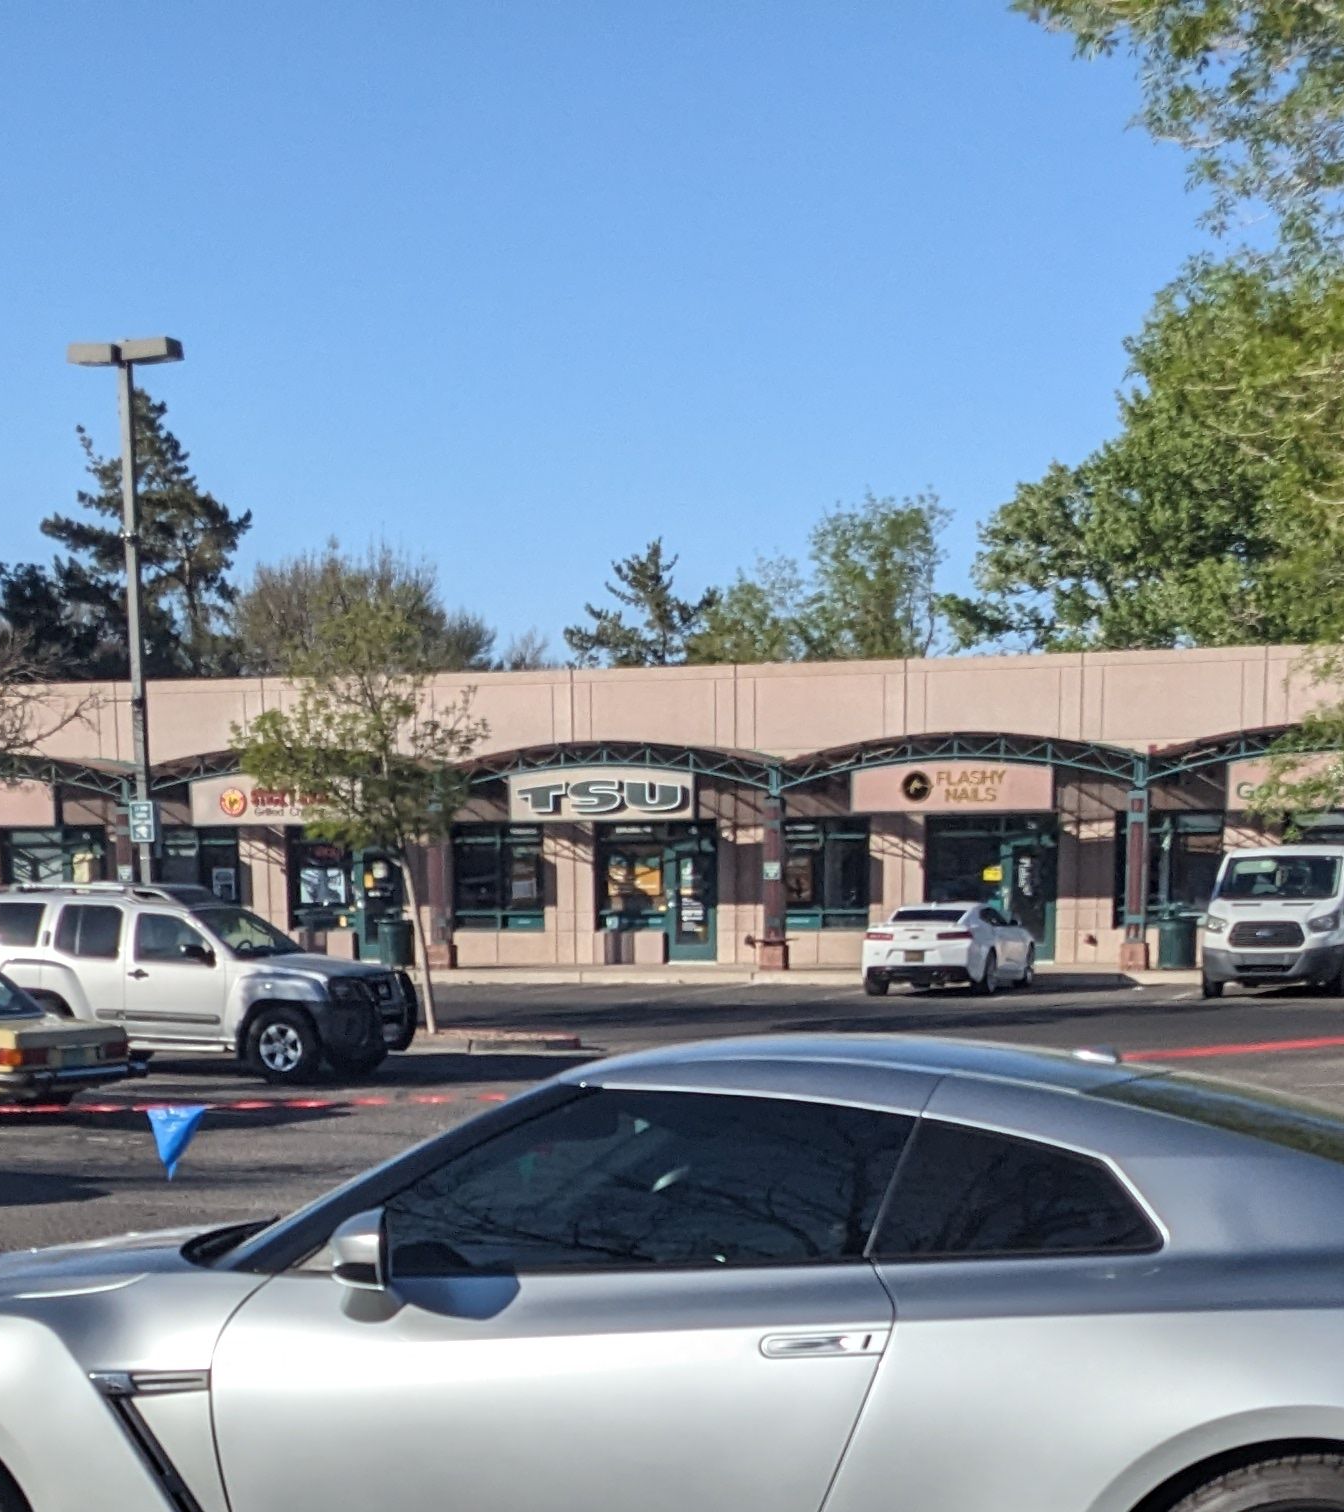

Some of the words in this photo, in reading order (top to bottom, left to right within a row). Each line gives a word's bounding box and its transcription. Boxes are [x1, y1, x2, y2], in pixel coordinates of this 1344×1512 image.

[936, 769, 1006, 786] FLASHY
[517, 780, 682, 814] TSU
[944, 787, 998, 803] NAILS
